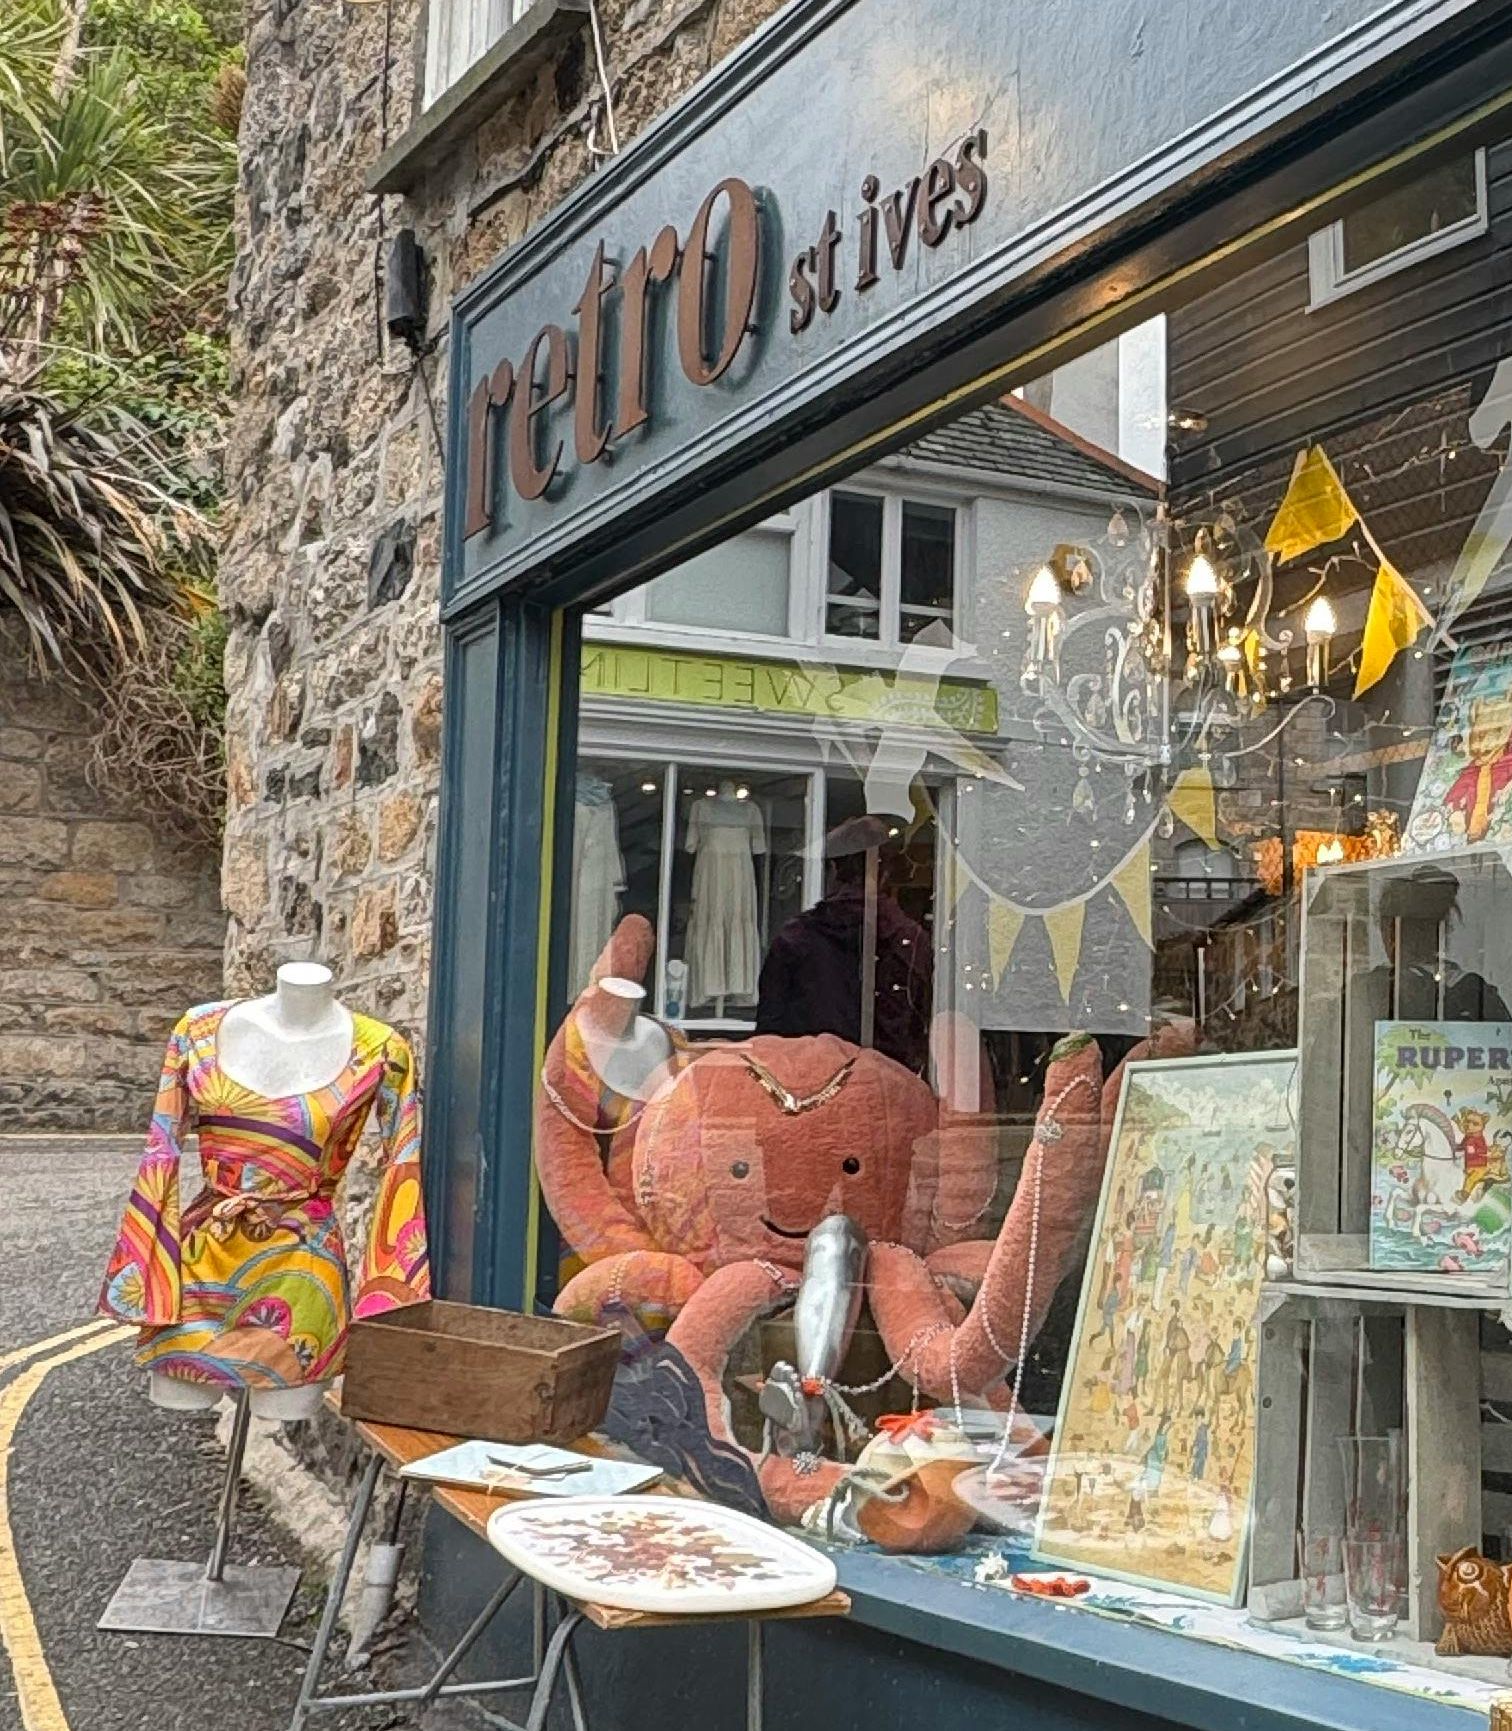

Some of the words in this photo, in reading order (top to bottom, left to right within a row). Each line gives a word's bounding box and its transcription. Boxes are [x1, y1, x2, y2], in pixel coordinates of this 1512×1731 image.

[463, 176, 761, 540] retro
[789, 210, 842, 335] st
[853, 128, 989, 292] ives
